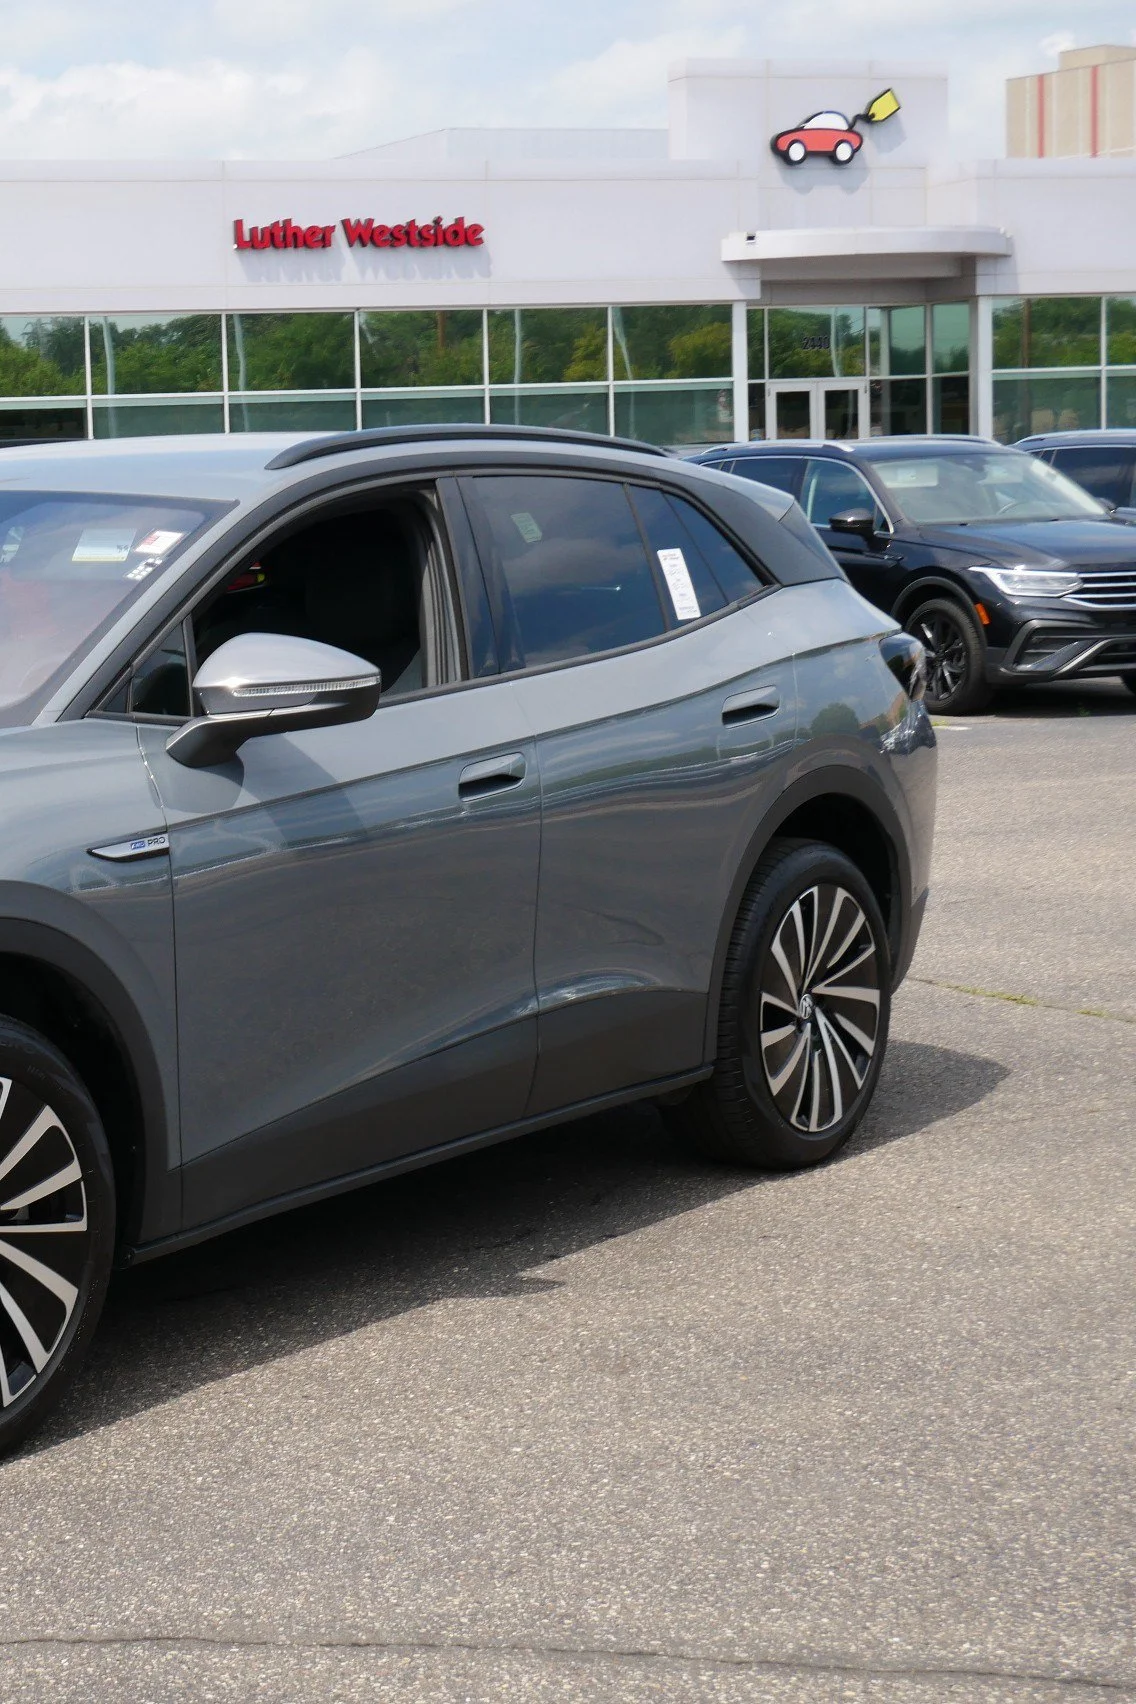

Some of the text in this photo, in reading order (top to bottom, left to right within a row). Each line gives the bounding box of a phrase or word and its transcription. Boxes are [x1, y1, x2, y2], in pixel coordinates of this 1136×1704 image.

[233, 216, 484, 248] Luther Westside
[147, 836, 166, 847] PRO
